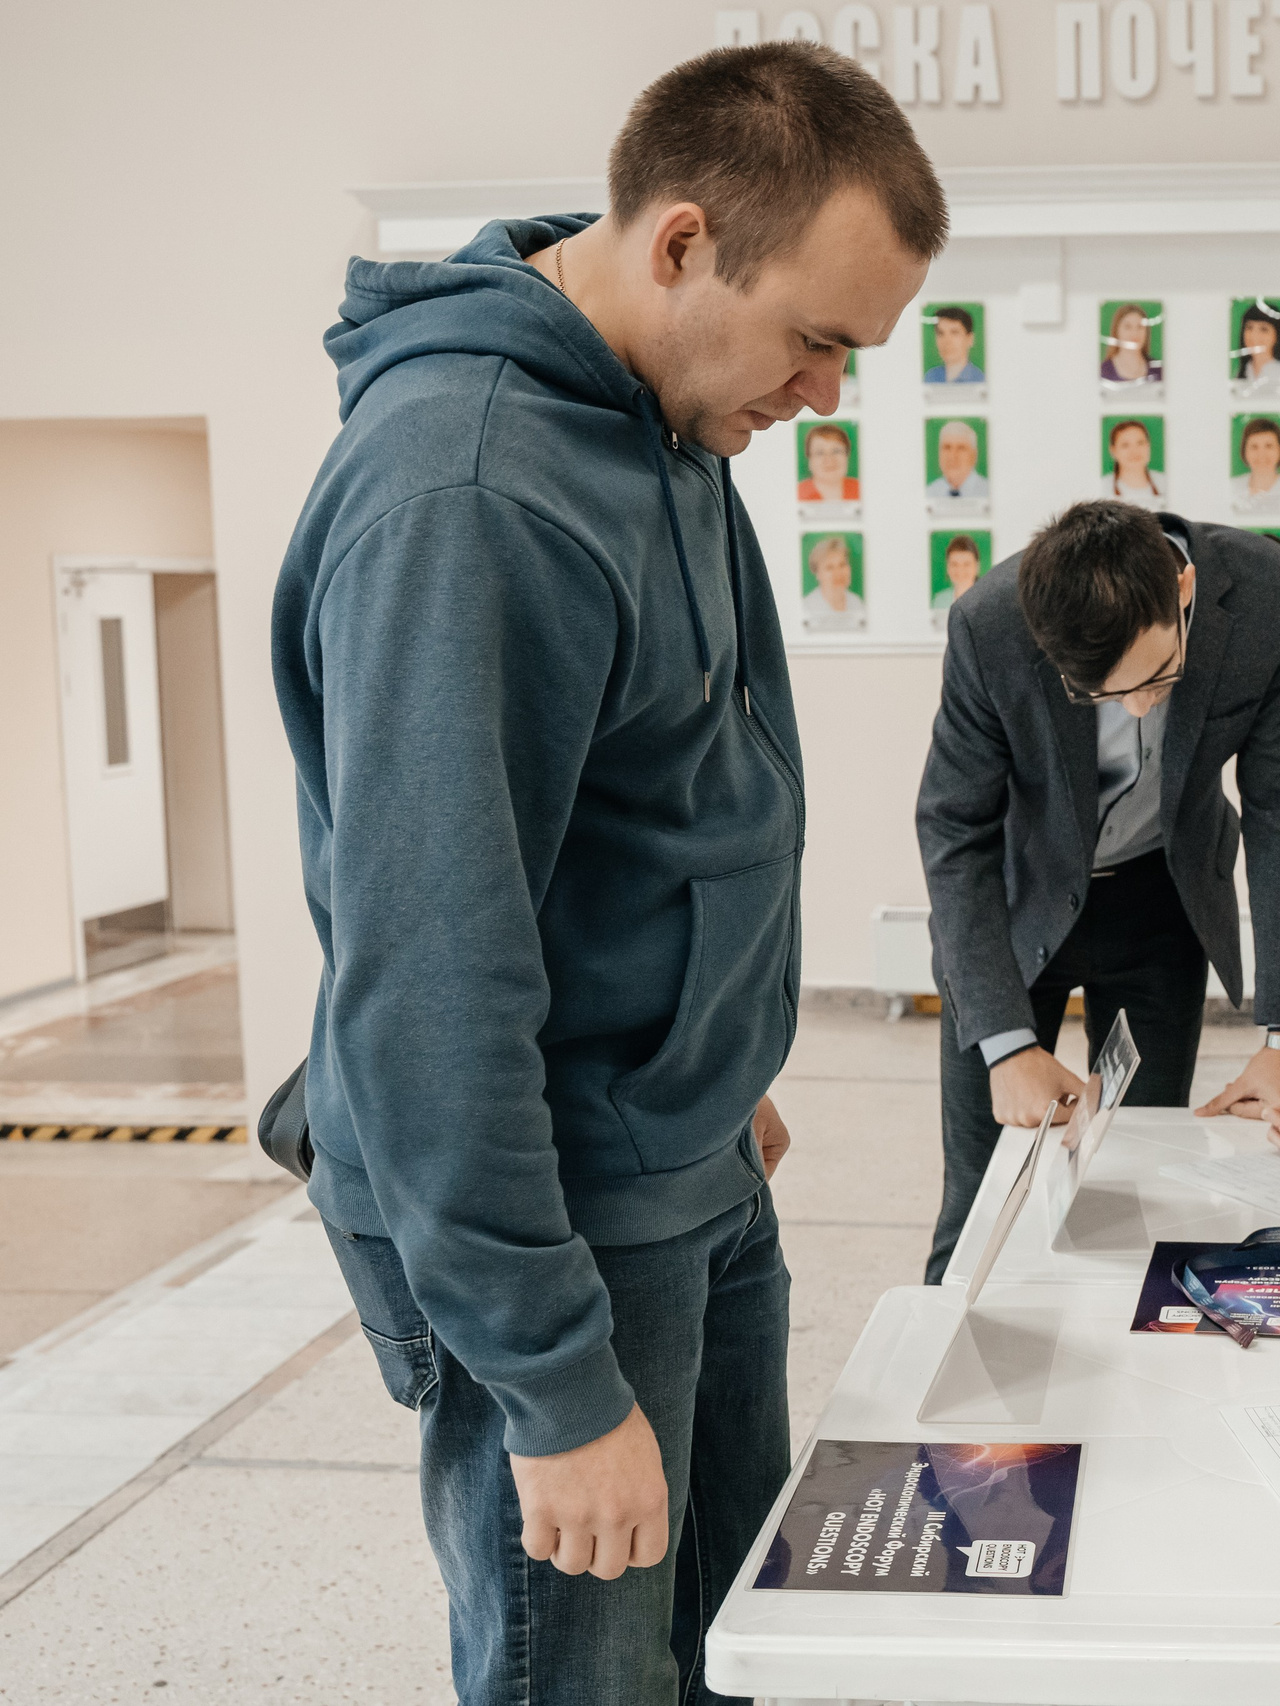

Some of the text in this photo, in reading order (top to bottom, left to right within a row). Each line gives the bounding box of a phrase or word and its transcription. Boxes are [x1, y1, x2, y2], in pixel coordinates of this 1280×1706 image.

[806, 1512, 846, 1575] QUESTIONS»
[840, 1488, 886, 1576] «HOT ENDOSCOPY
[872, 1462, 929, 1577] Эндоскопический Форум
[910, 1511, 947, 1577] III Сибирский
[1016, 1544, 1028, 1554] HOT
[983, 1544, 997, 1568] QUESTIONS
[998, 1544, 1012, 1571] ENDOSCOPY
